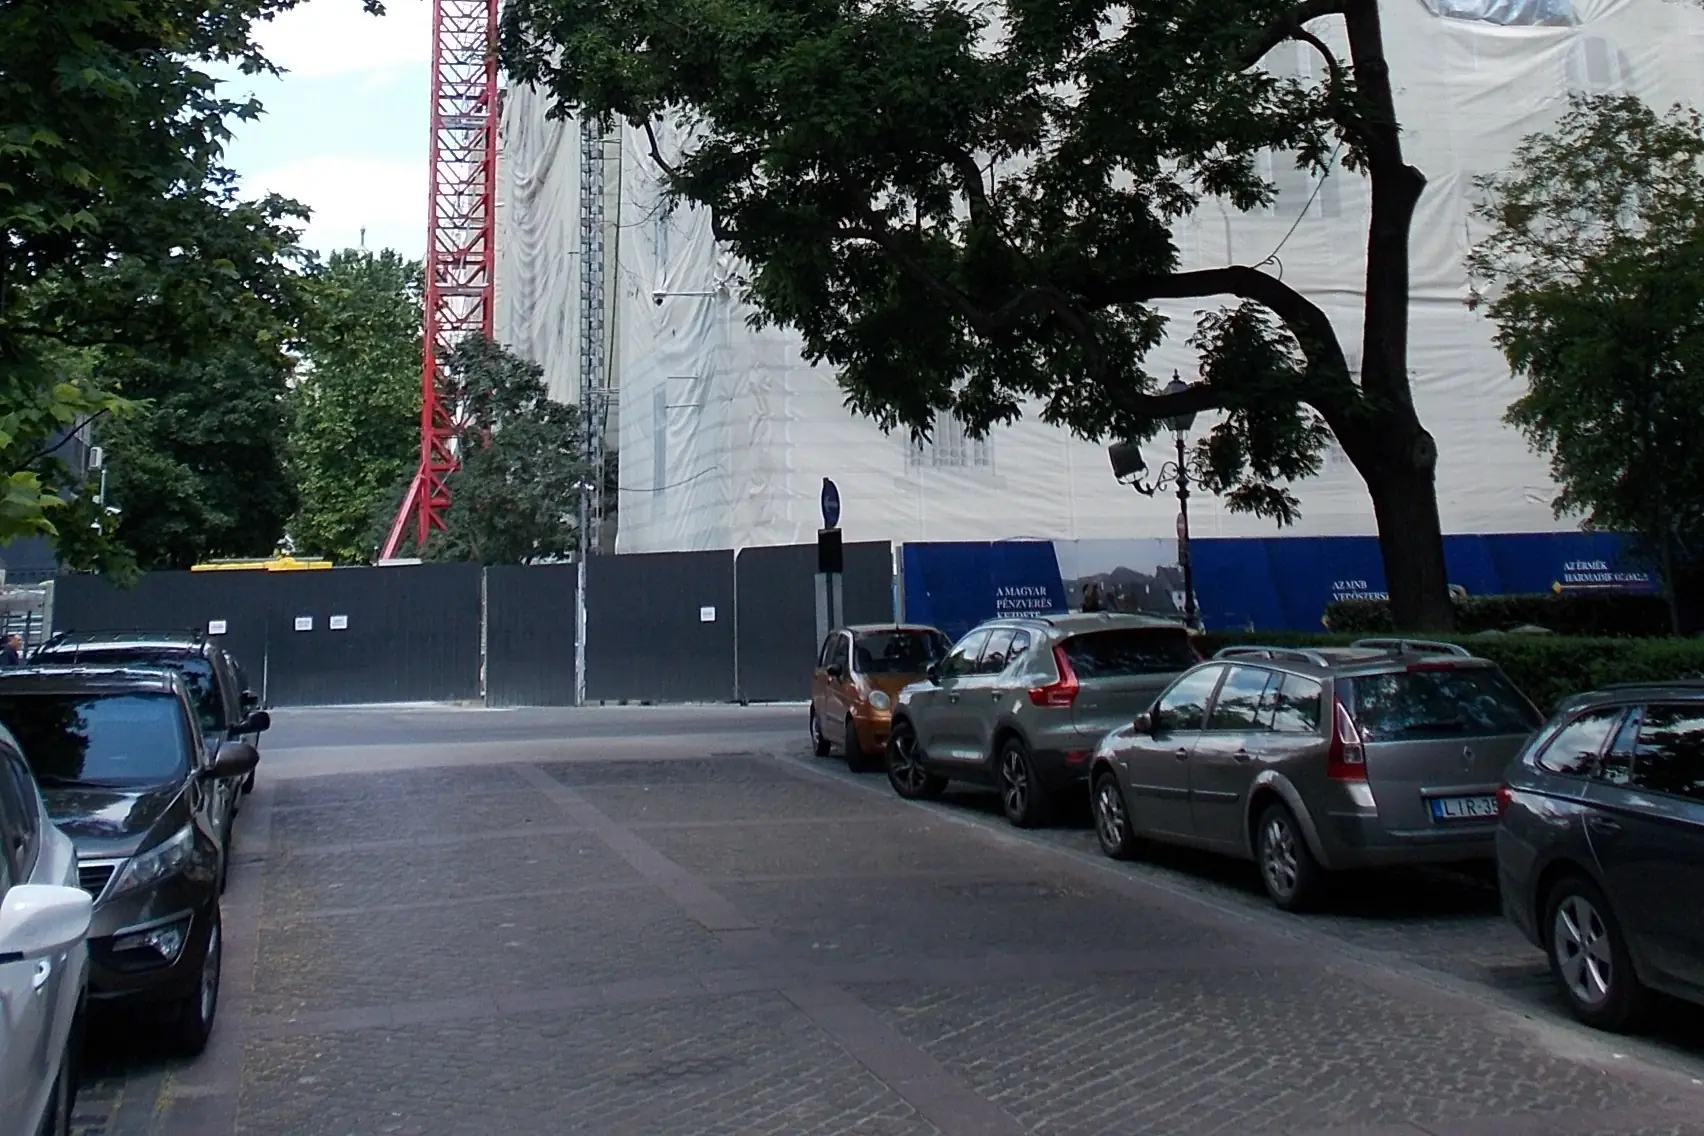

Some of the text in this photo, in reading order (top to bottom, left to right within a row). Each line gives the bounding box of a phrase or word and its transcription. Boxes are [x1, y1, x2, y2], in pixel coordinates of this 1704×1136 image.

[1332, 580, 1367, 590] AZ MNB
[996, 586, 1047, 596] A MAGYAR
[996, 597, 1052, 609] PÉNZVERÉS
